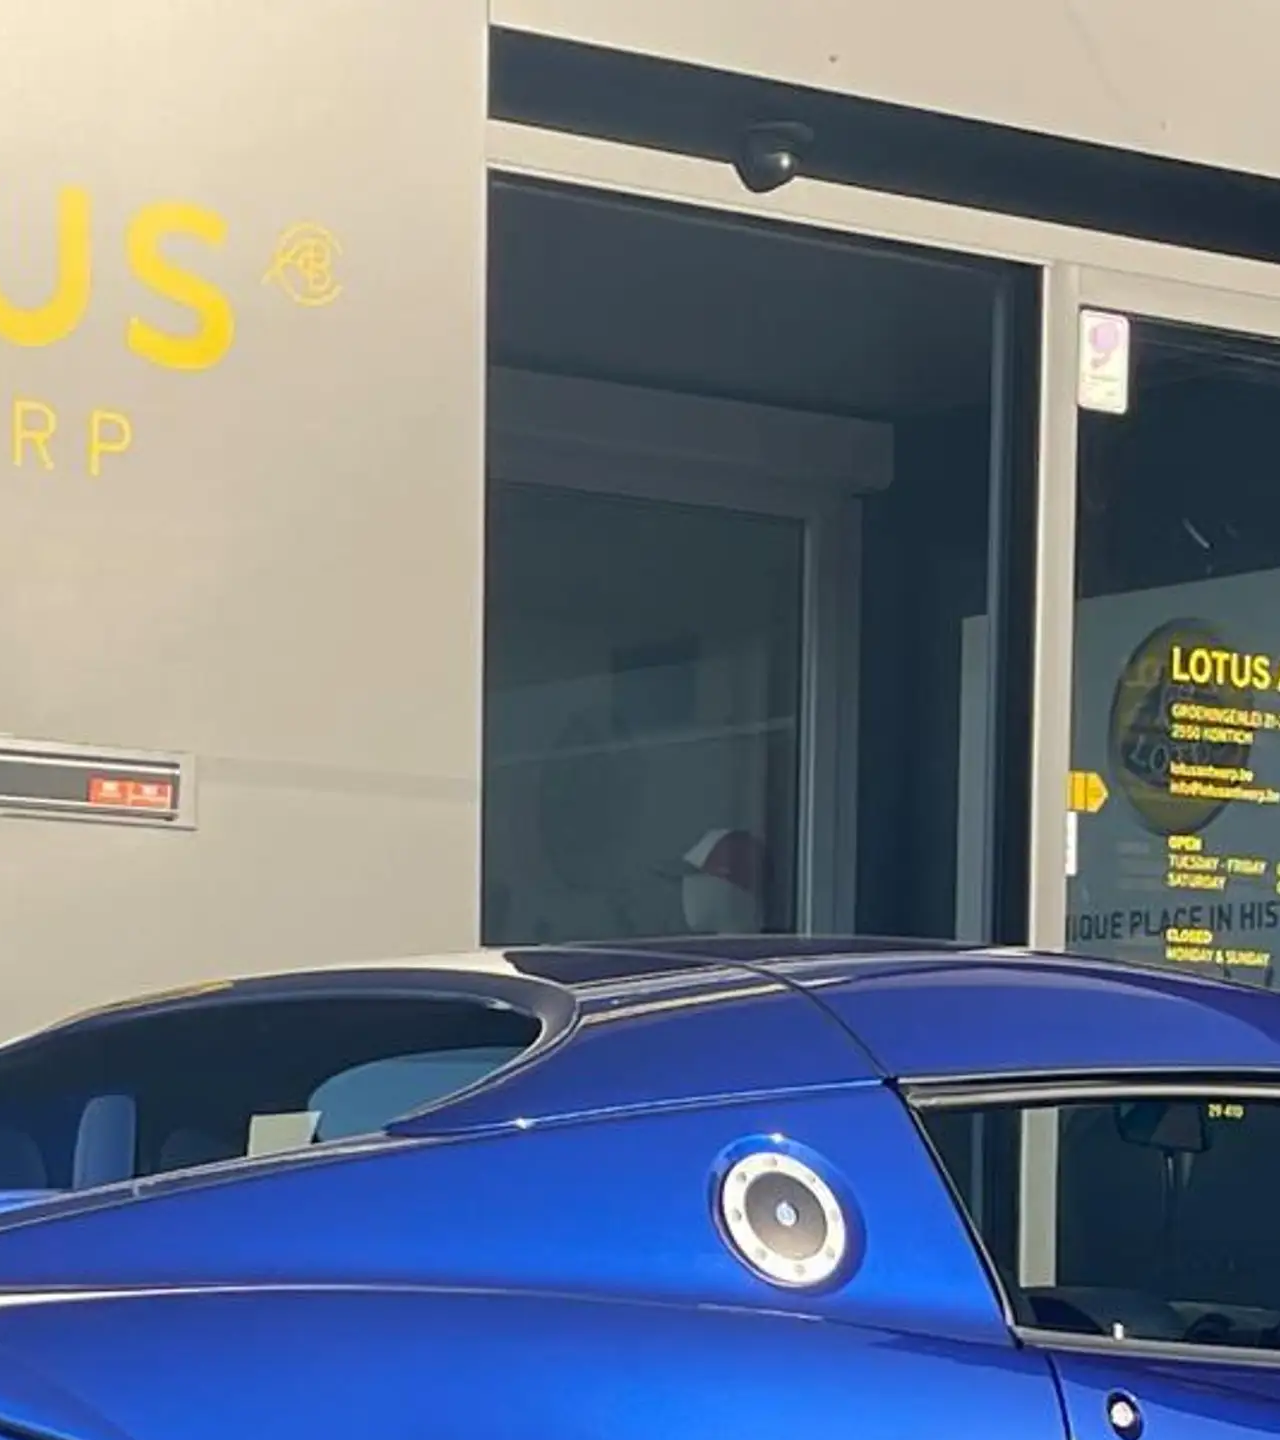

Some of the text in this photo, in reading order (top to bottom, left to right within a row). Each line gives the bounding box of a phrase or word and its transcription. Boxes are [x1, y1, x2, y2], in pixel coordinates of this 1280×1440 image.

[1172, 645, 1270, 690] LOTUS
[1168, 835, 1202, 851] OPEN
[1227, 858, 1268, 875] FRIDAY
[1167, 872, 1227, 890] SATURDAY
[1129, 906, 1203, 938] PLACE
[1209, 903, 1233, 932] IN
[1166, 928, 1213, 944] CLOSED
